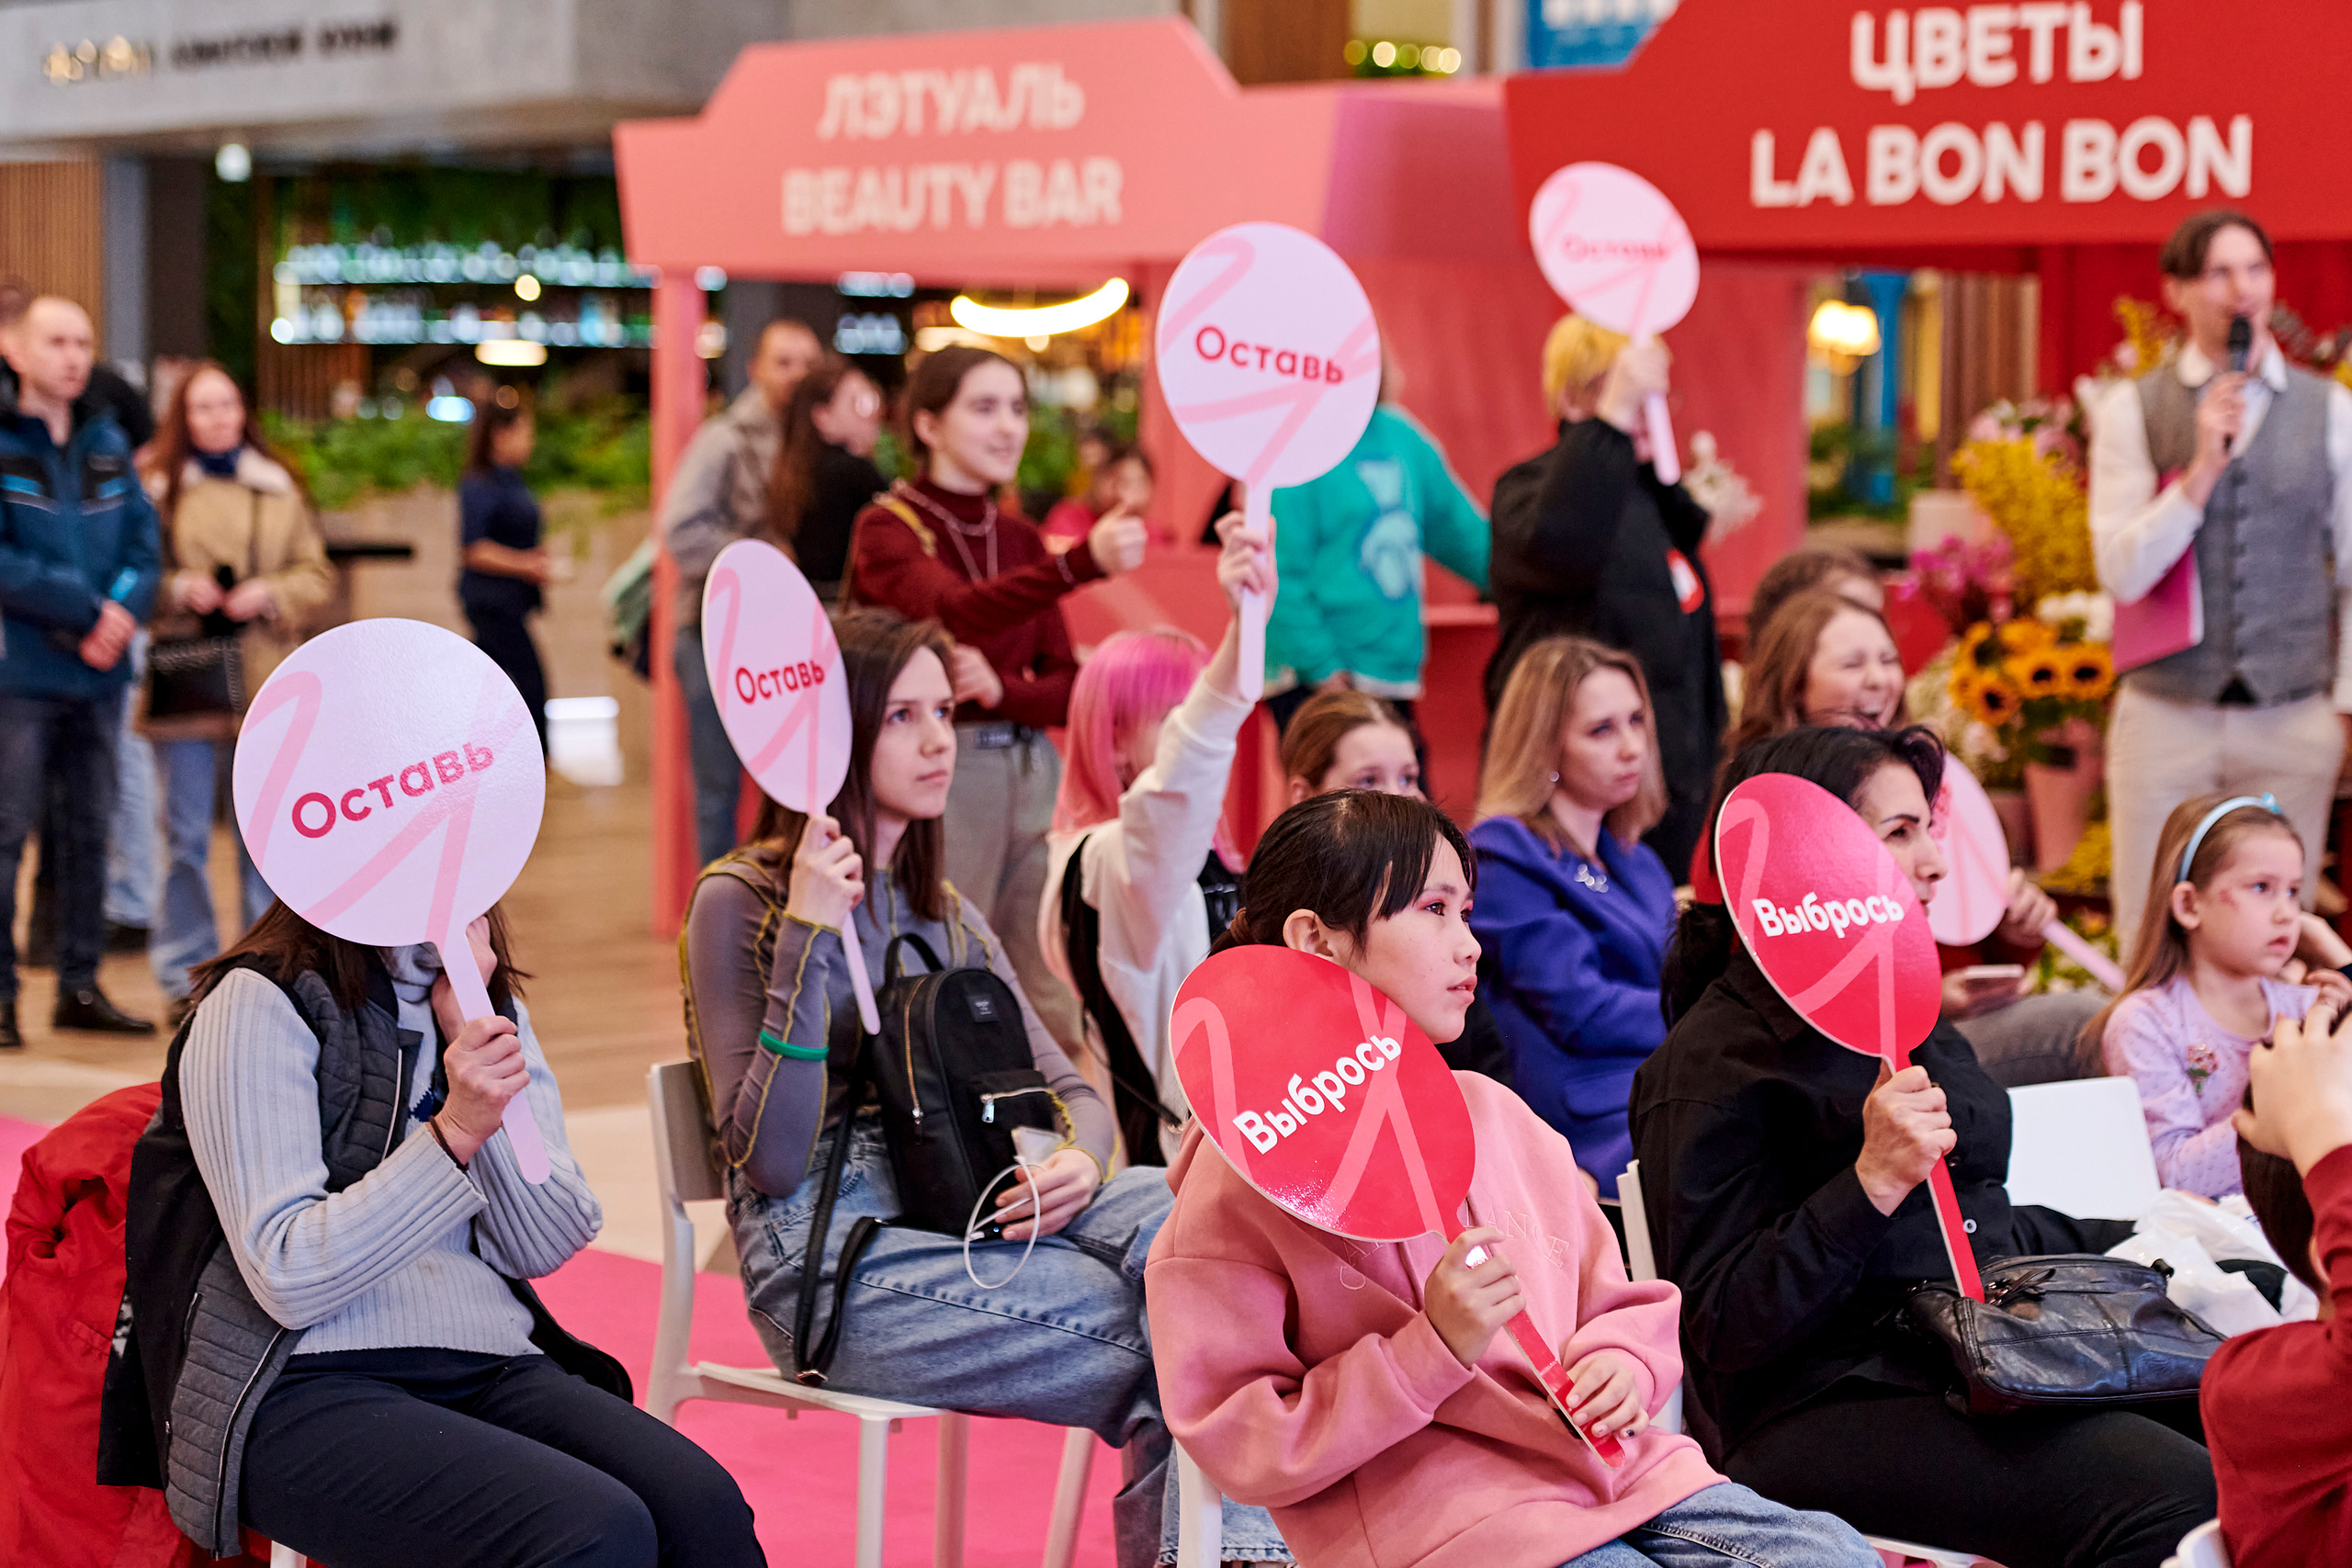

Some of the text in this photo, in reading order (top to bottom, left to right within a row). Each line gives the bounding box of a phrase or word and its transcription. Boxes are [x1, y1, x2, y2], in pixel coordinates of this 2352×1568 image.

[1850, 1, 2143, 106] ЦВЕТЫ
[817, 62, 1085, 141] ЛЭТУАЛЬ
[781, 155, 1123, 235] BEAUTY BAR
[1750, 113, 2253, 208] LA BON BON
[1195, 325, 1344, 385] Оставь
[735, 659, 825, 705] Оставь
[291, 742, 494, 839] Оставь
[1751, 891, 1905, 939] Выбрось
[1232, 1035, 1402, 1155] Выбрось
